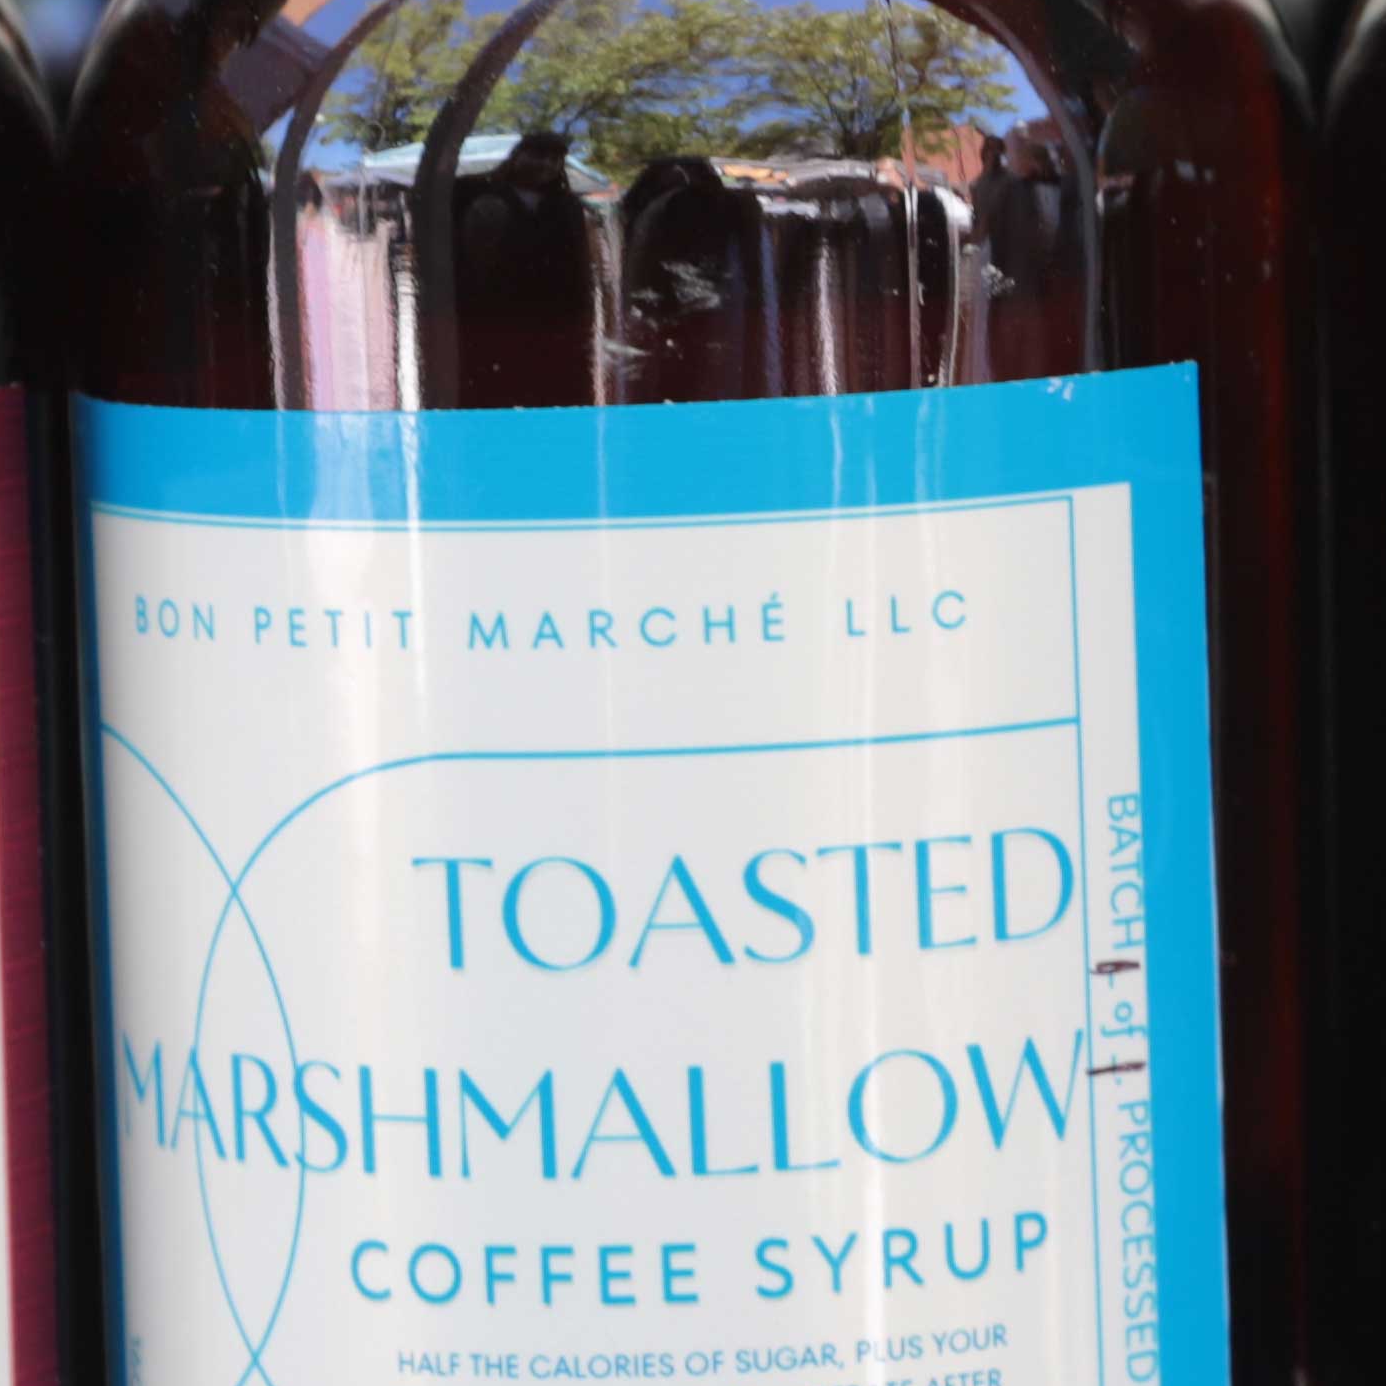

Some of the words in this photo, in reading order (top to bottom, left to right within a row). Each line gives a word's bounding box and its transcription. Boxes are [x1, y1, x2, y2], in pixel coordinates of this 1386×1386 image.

[136, 595, 215, 640] BON
[254, 607, 411, 649] PETIT
[469, 593, 786, 649] MARCHÉ
[845, 590, 967, 637] LLC
[412, 827, 1075, 971] TOASTED
[1107, 792, 1144, 949] BATCH
[122, 1028, 1084, 1179] MARSHMALLOW
[351, 1239, 700, 1305] COFFEE
[755, 1211, 1049, 1300] SYRUP
[1117, 1099, 1159, 1384] PROCESSED
[397, 1350, 461, 1377] HALF
[470, 1352, 520, 1379] THE
[529, 1352, 675, 1380] CALORIES
[685, 1350, 724, 1376] OF
[735, 1343, 845, 1375] SUGAR,
[855, 1335, 923, 1363] PLUS
[932, 1323, 1009, 1356] YOUR
